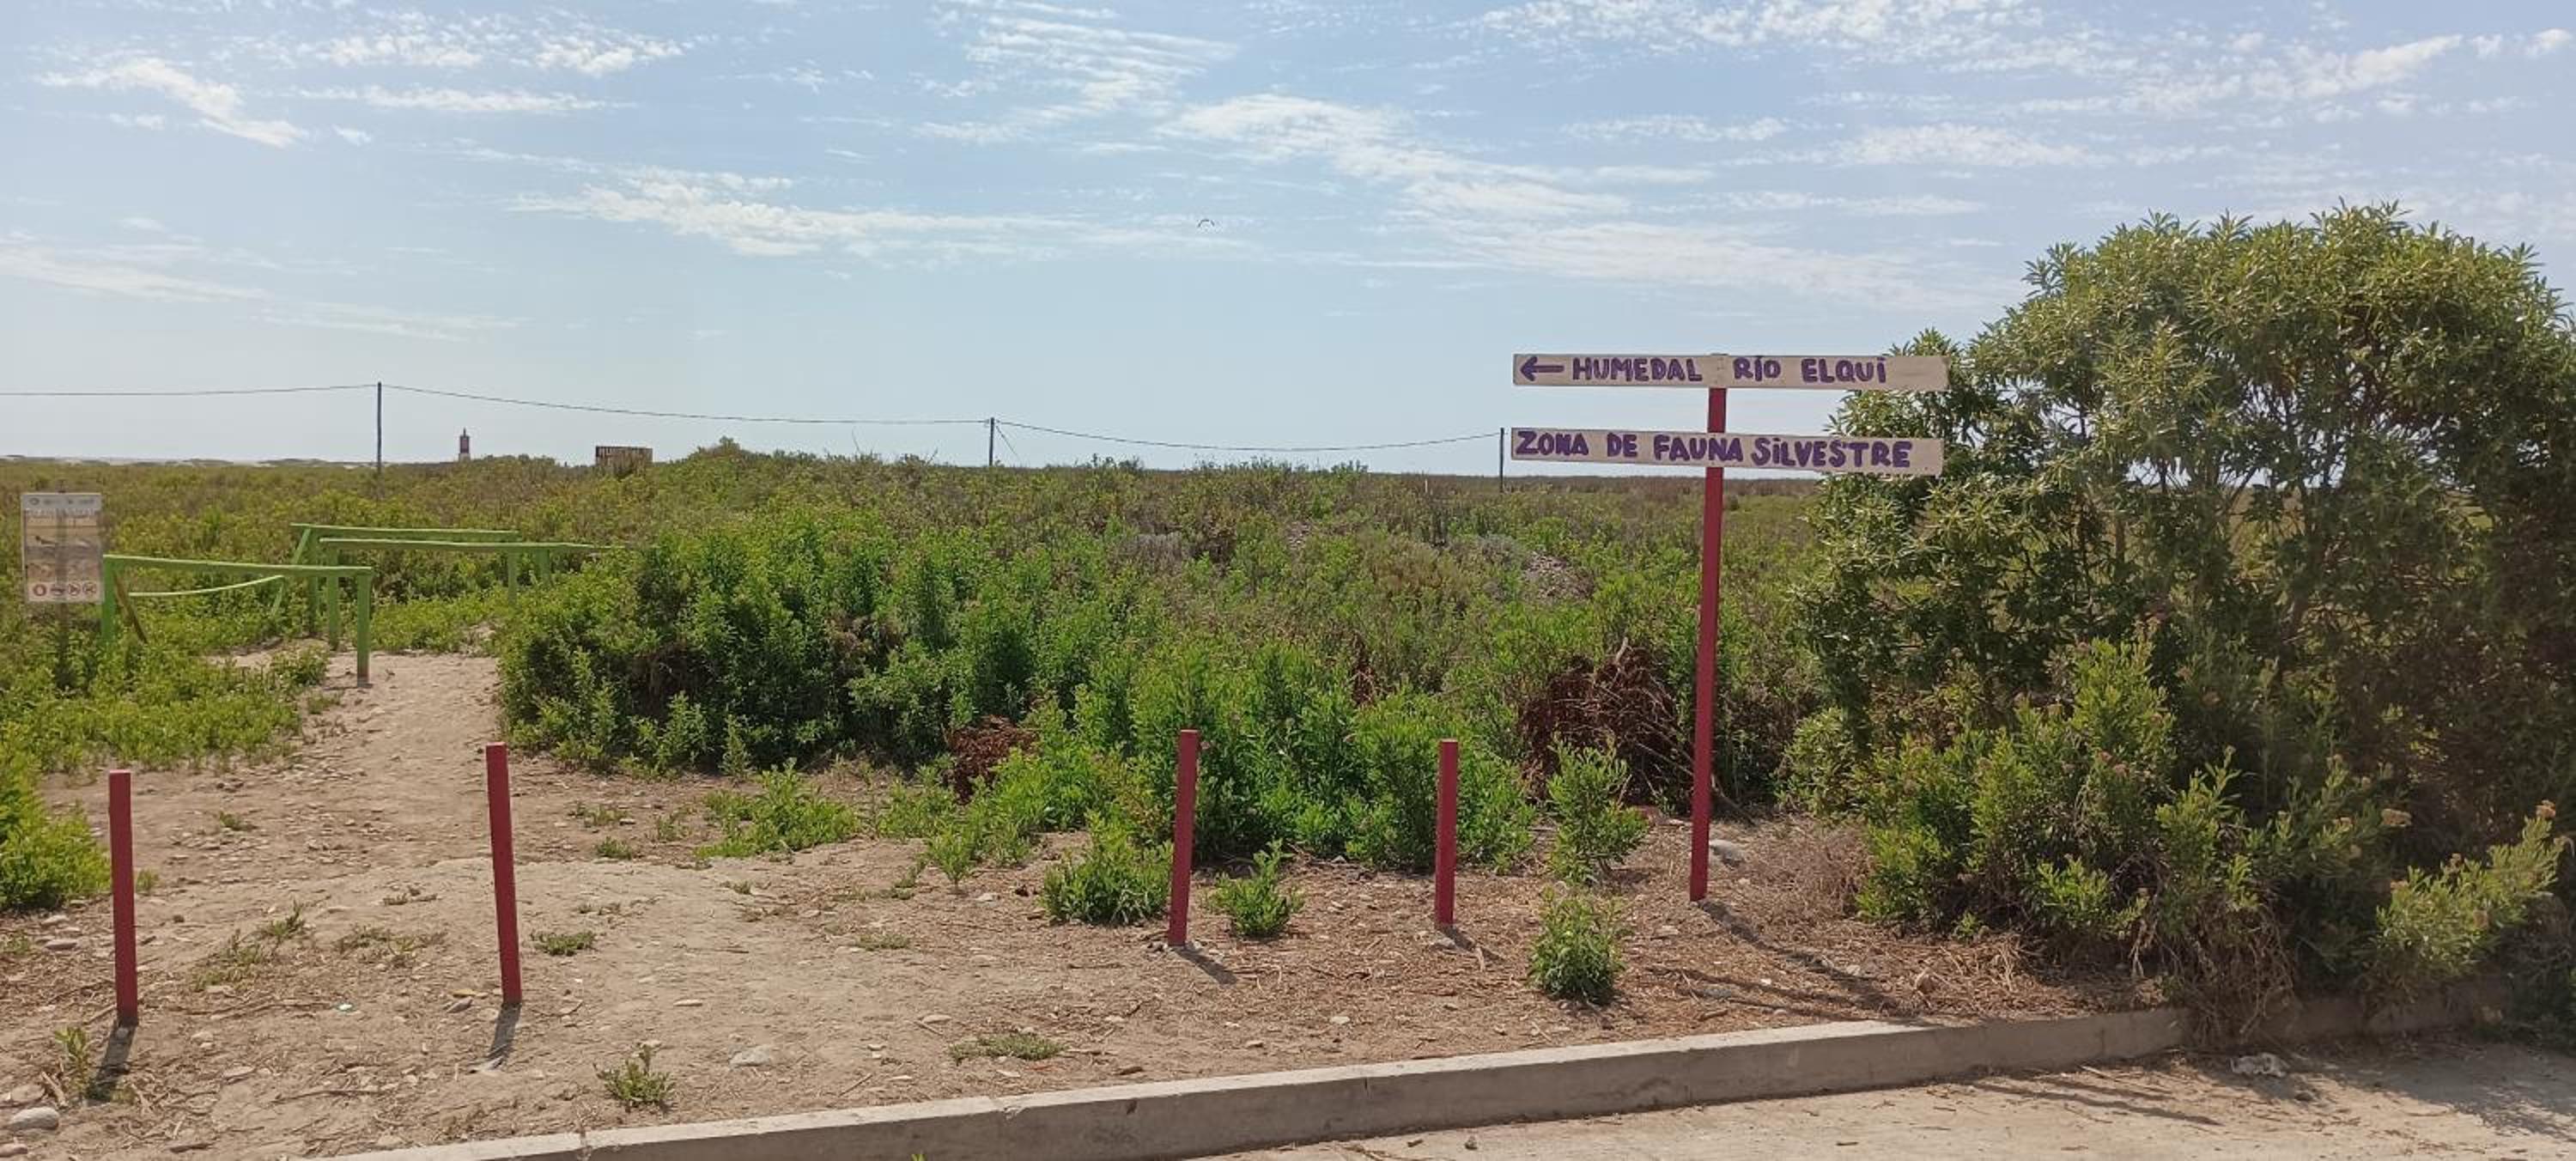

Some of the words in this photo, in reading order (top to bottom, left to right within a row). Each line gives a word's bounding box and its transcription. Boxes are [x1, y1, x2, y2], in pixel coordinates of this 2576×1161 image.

[1572, 356, 1703, 381] HUMEDAL
[1516, 430, 1589, 456] ZONA
[1607, 433, 1638, 458] DE
[1654, 434, 1744, 461] FAUNA
